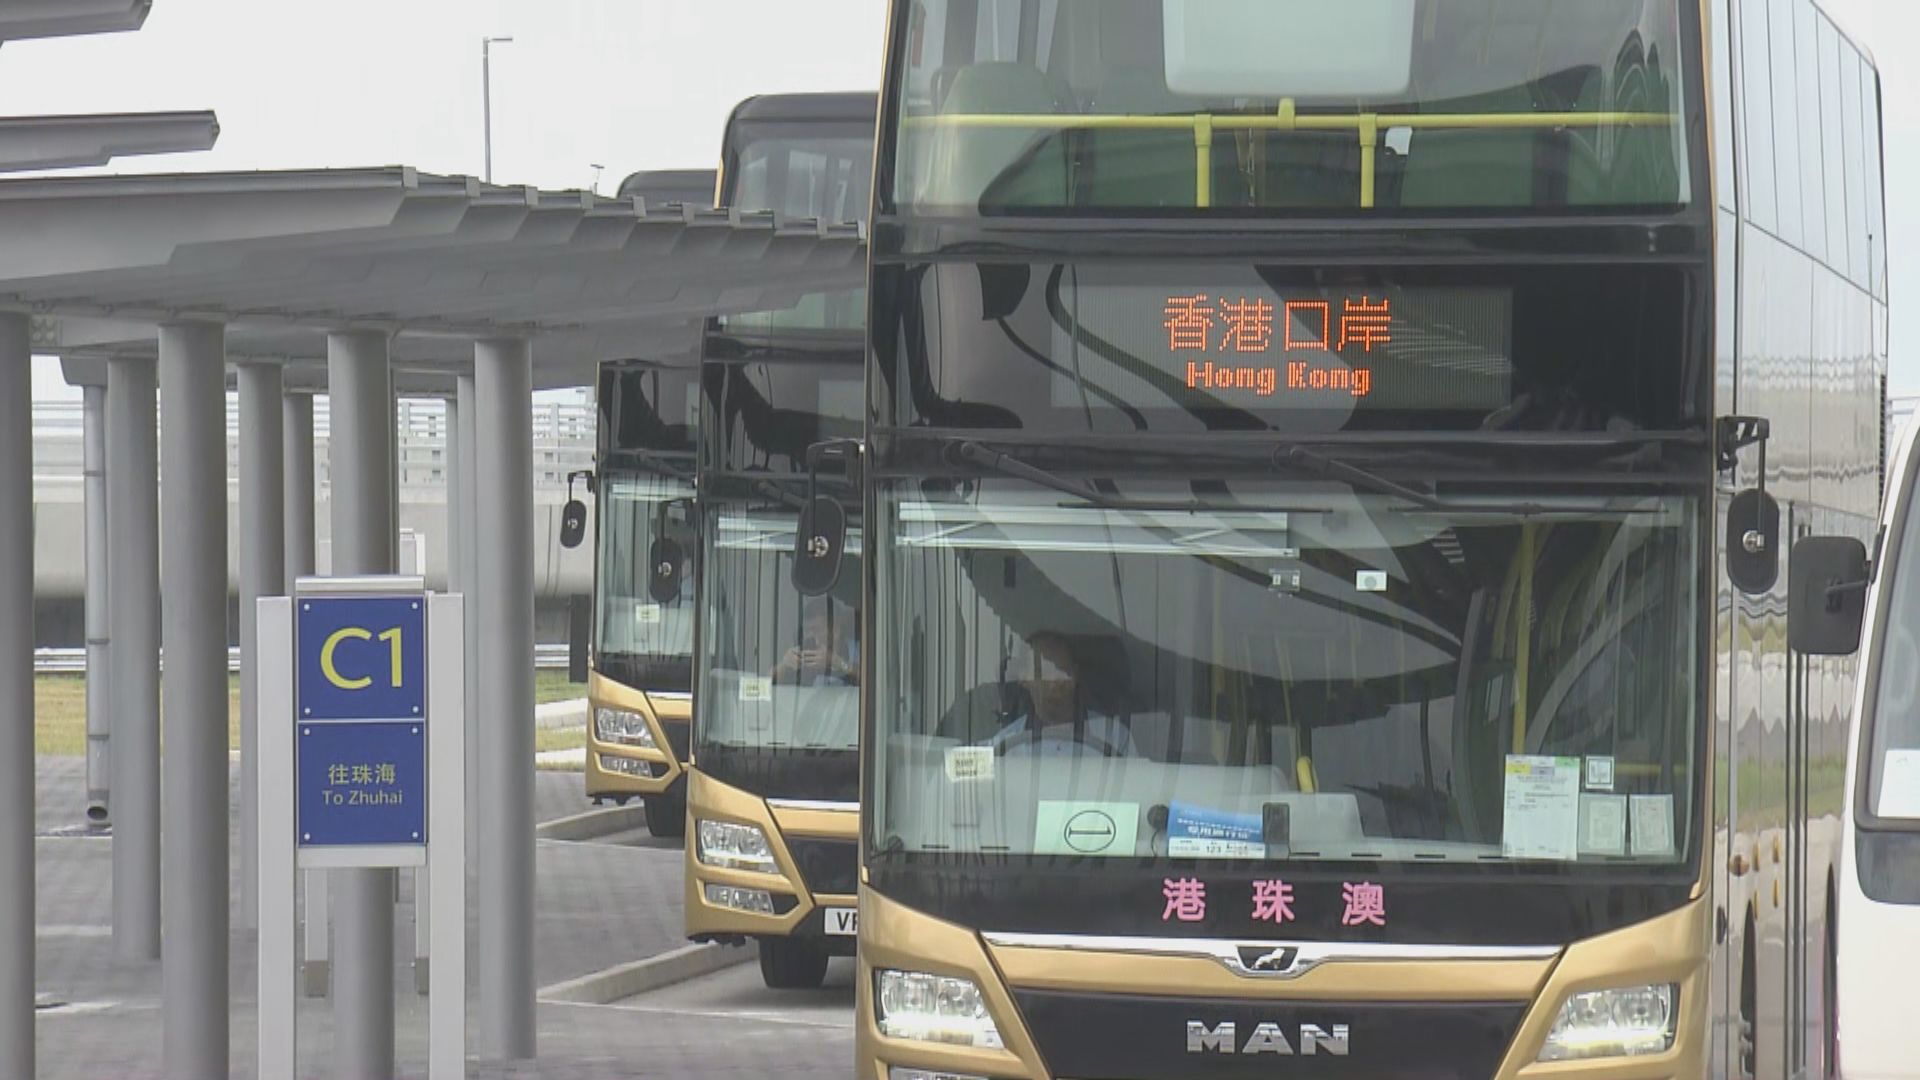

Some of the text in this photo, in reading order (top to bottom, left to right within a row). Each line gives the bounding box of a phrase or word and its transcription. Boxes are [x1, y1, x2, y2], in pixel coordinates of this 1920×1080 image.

[1163, 294, 1392, 352] 香港口岸
[1187, 361, 1371, 395] Hong Kong
[320, 626, 403, 689] C1
[328, 763, 396, 785] 往珠海
[322, 788, 403, 805] To Zhuhai
[1186, 1019, 1349, 1055] MAN
